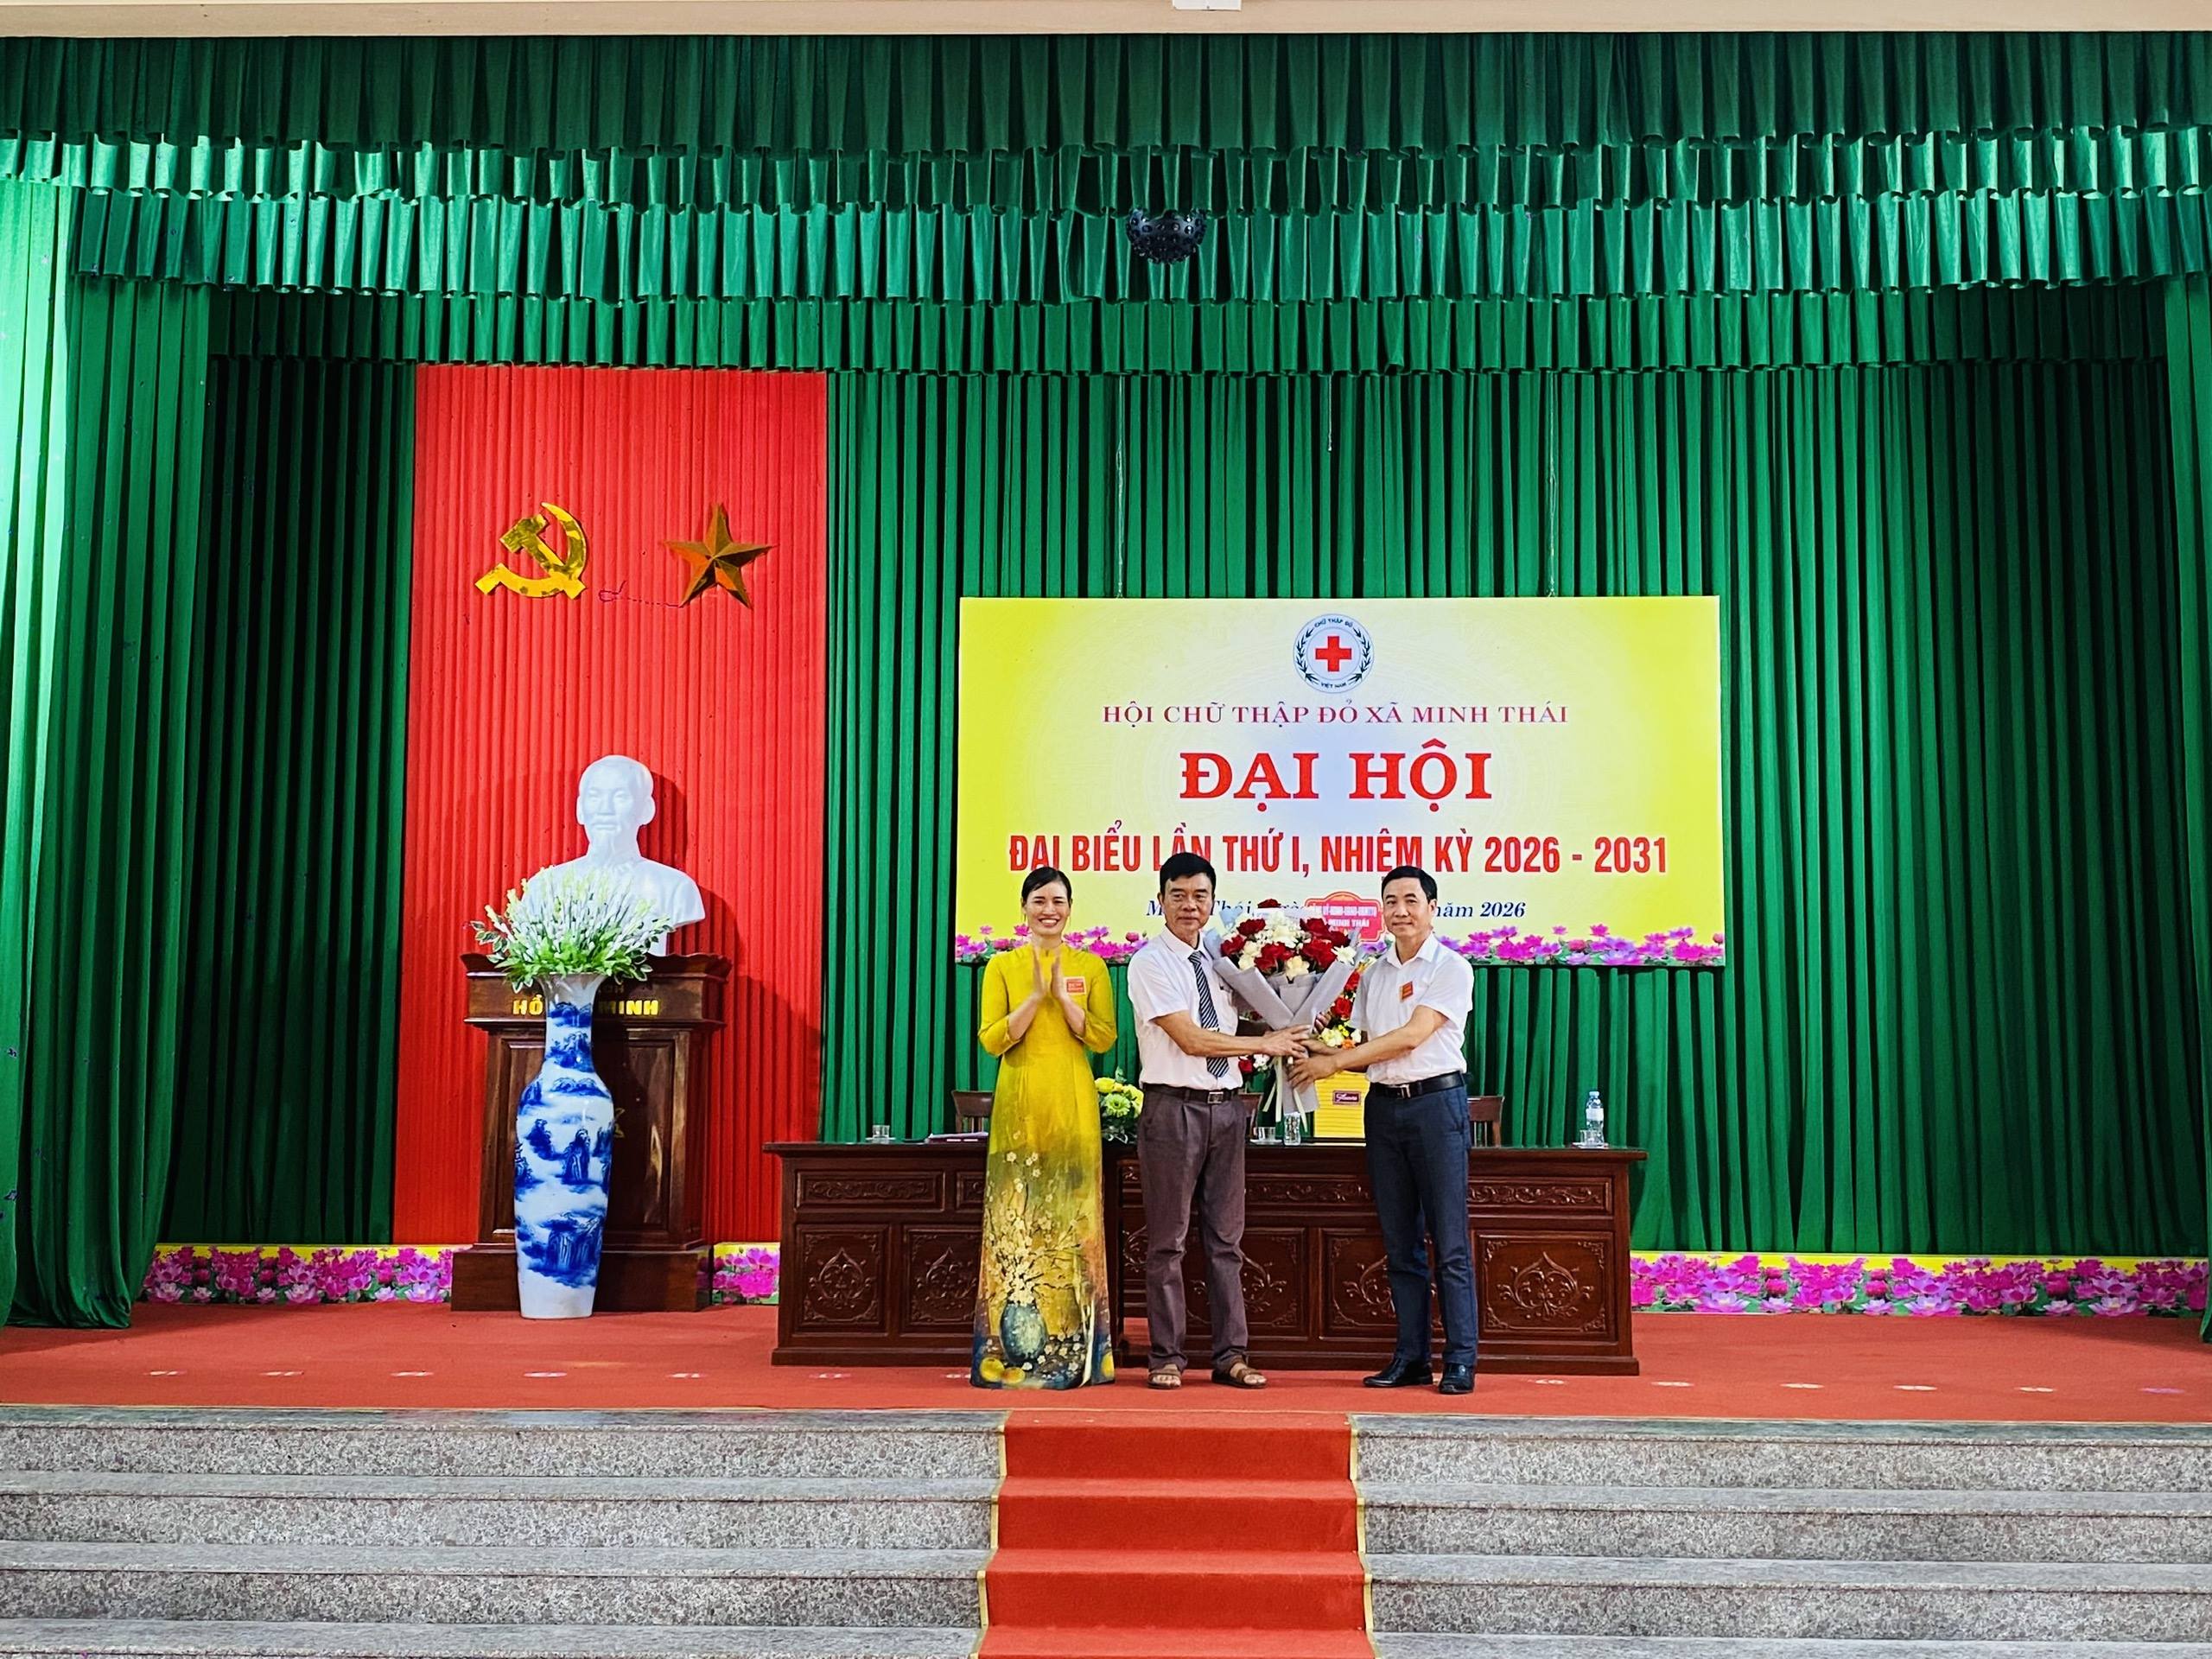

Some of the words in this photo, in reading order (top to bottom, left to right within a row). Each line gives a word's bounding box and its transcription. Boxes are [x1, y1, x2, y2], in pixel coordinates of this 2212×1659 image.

[1103, 701, 1154, 728] HỘI
[1163, 702, 1226, 723] CHỮ
[1231, 701, 1309, 728] THẬP
[1317, 698, 1358, 724] ĐỎ
[1364, 702, 1403, 723] XÃ
[1411, 706, 1489, 723] MINH
[1497, 700, 1568, 723] THÁI
[1179, 753, 1319, 812] ĐẠI
[1348, 738, 1492, 812] HỘI
[1071, 819, 1141, 872] BIỂU
[1222, 827, 1284, 873] THỨ
[1292, 836, 1309, 878] I,
[1321, 828, 1423, 880] NHIỆM
[1434, 828, 1473, 873] KỲ
[1484, 836, 1560, 874] 2026
[1594, 836, 1666, 874] 2031
[1479, 901, 1526, 918] 2026
